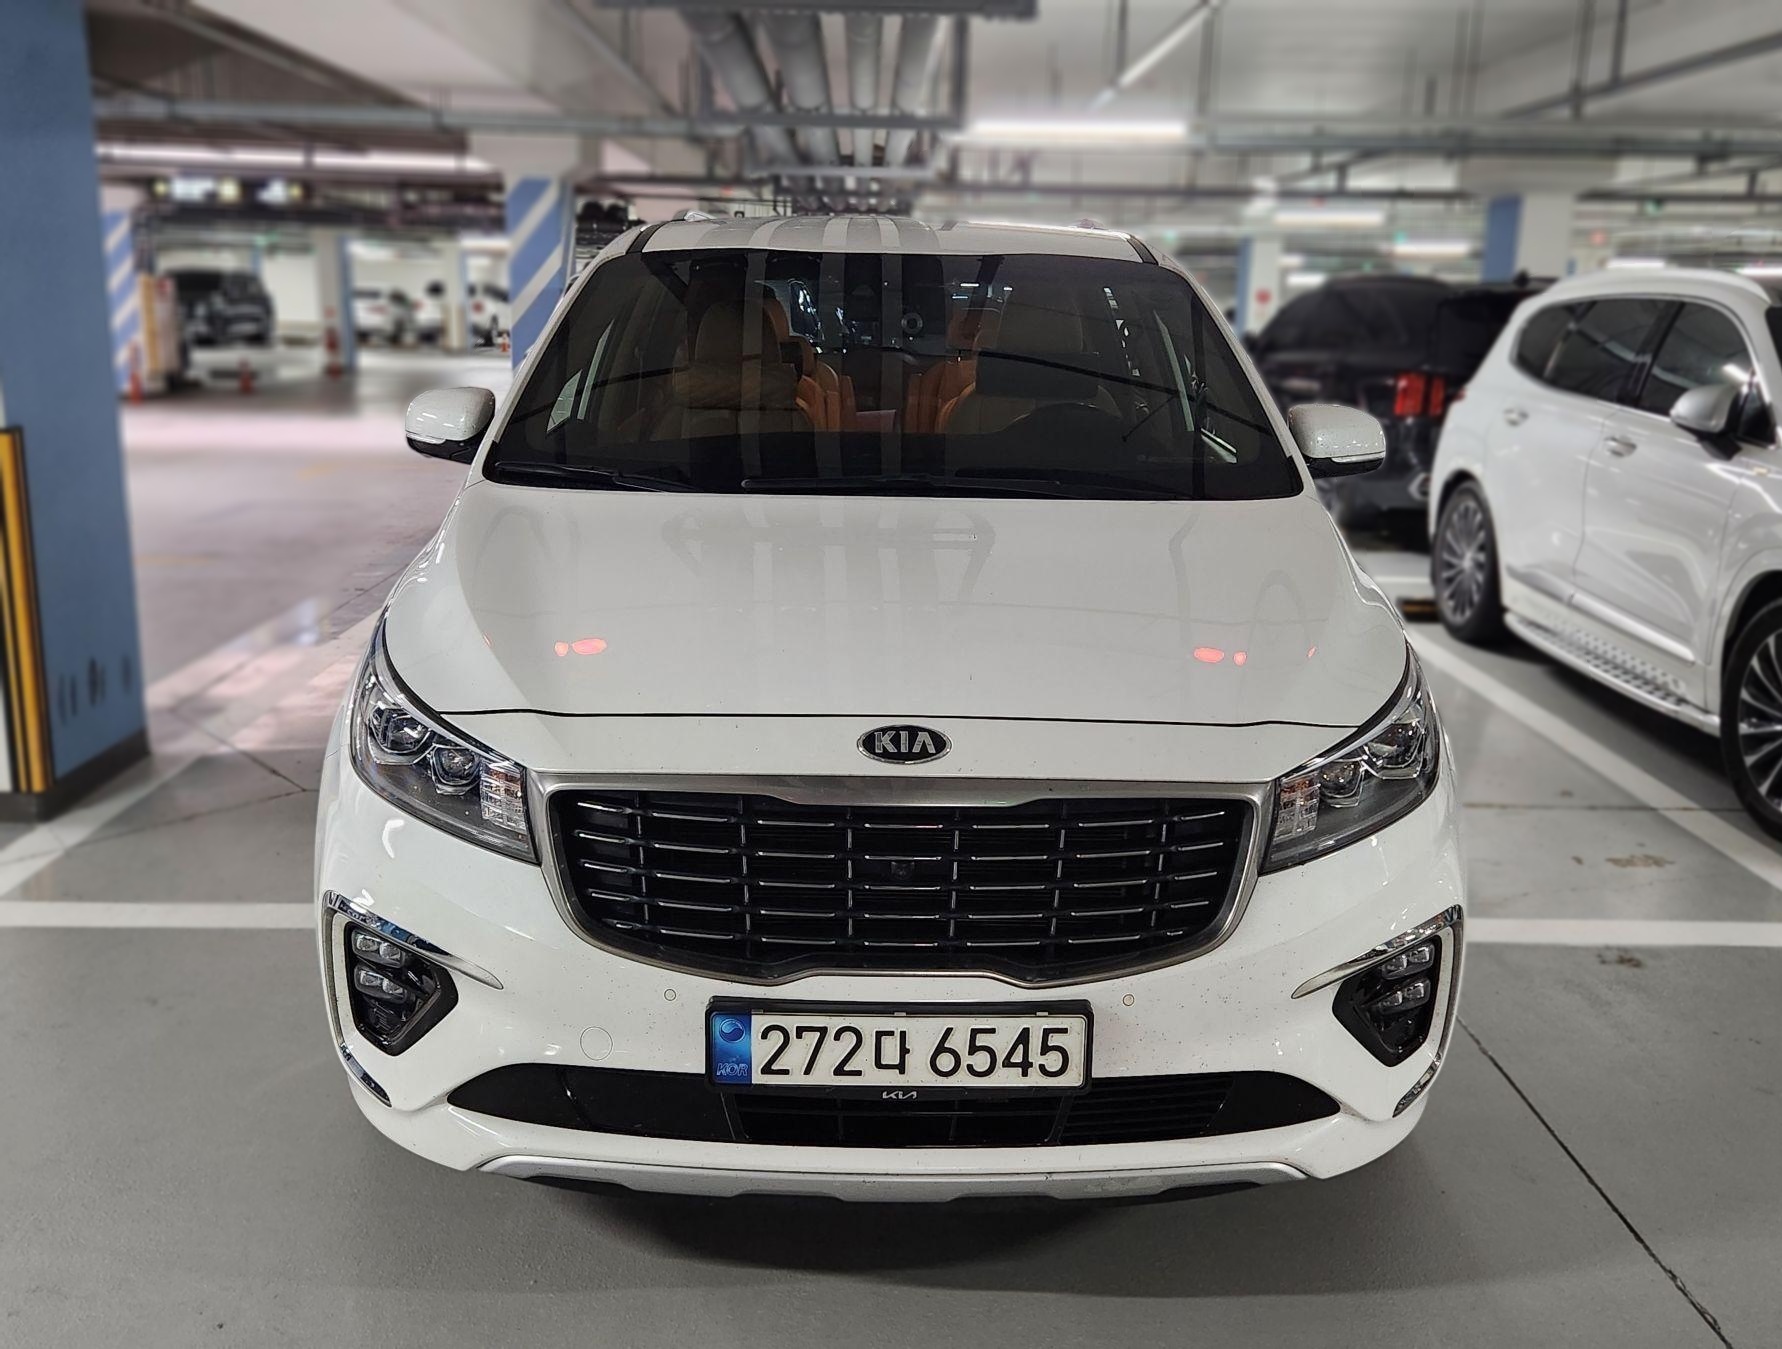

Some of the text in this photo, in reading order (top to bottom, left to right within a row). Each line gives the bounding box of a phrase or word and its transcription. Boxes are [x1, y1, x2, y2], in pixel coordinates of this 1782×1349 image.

[874, 731, 936, 754] KIA
[760, 1024, 1070, 1078] 272다 6545
[716, 1062, 749, 1077] KOR
[882, 1090, 917, 1099] KIA
